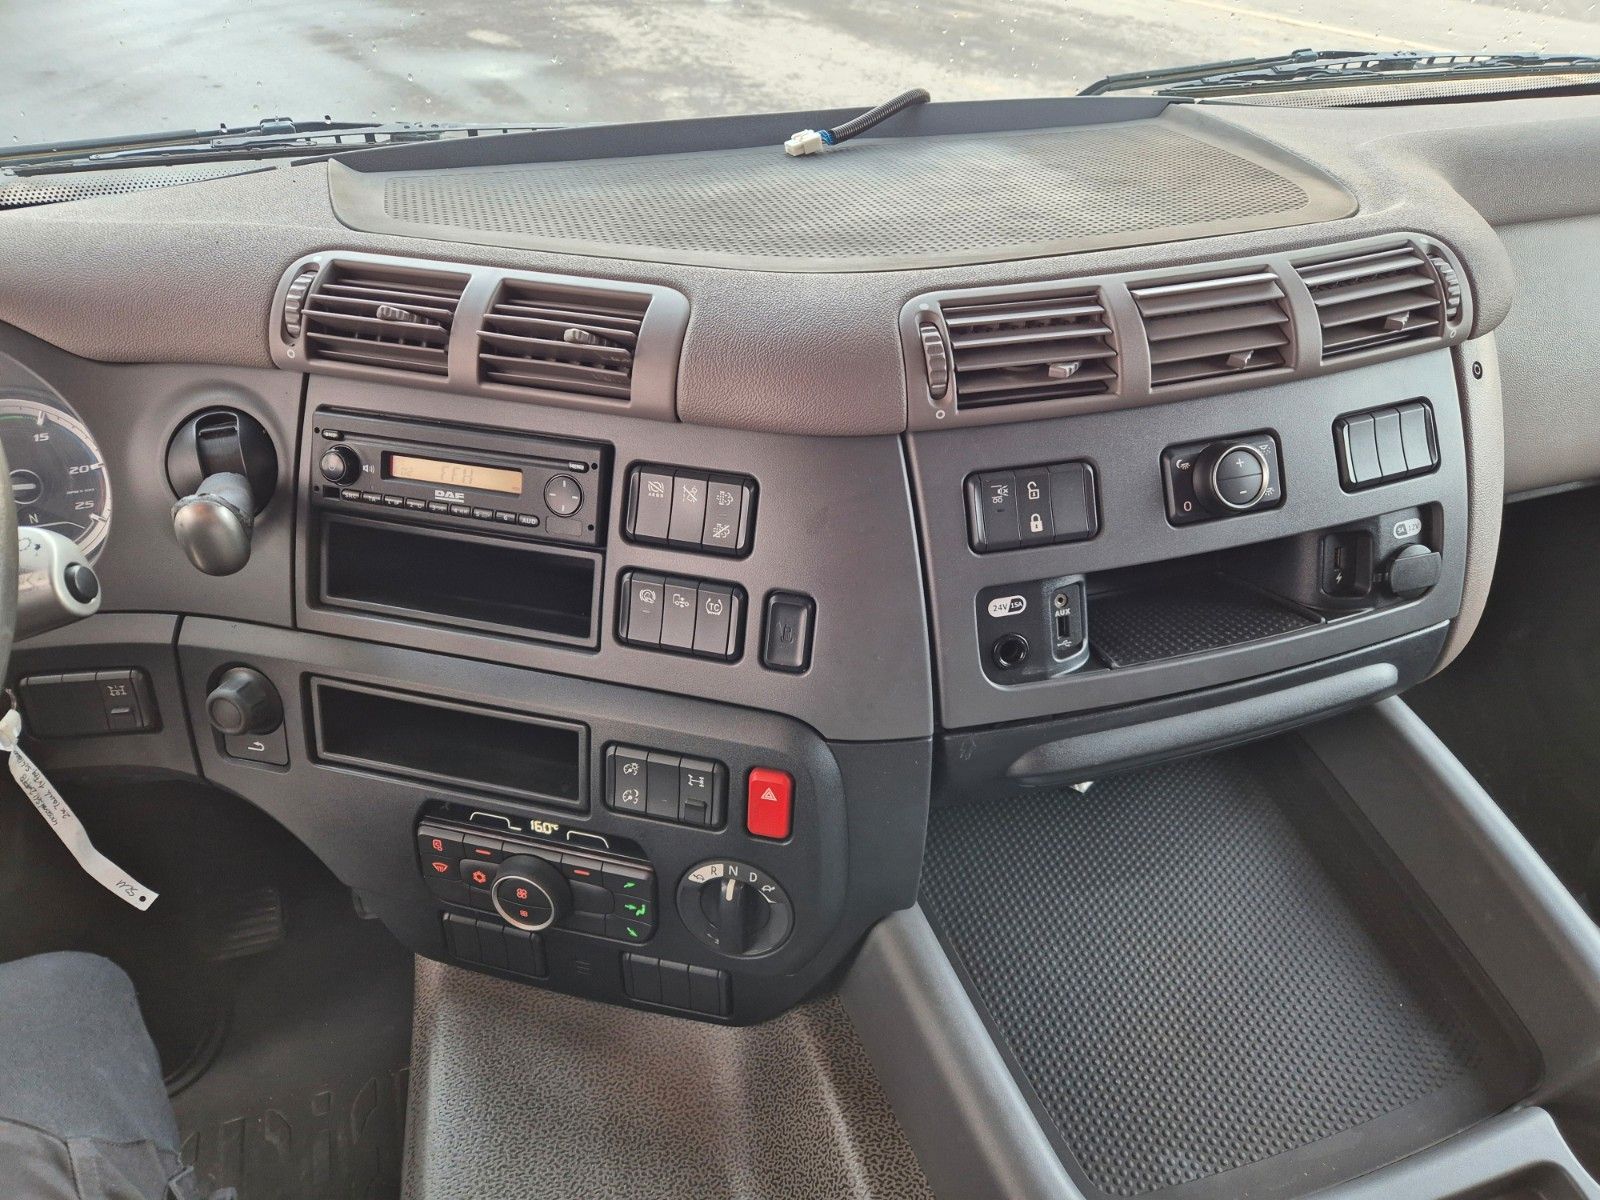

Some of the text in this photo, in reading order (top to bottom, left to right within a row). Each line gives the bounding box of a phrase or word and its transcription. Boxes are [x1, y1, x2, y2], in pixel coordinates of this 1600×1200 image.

[33, 433, 50, 442] 15
[69, 465, 89, 475] 20
[434, 490, 464, 499] DAF
[75, 500, 95, 510] 25
[28, 513, 39, 523] N
[708, 603, 720, 612] TC
[993, 603, 1008, 612] 24V
[1054, 608, 1071, 617] AUX
[711, 865, 758, 882] R N D
